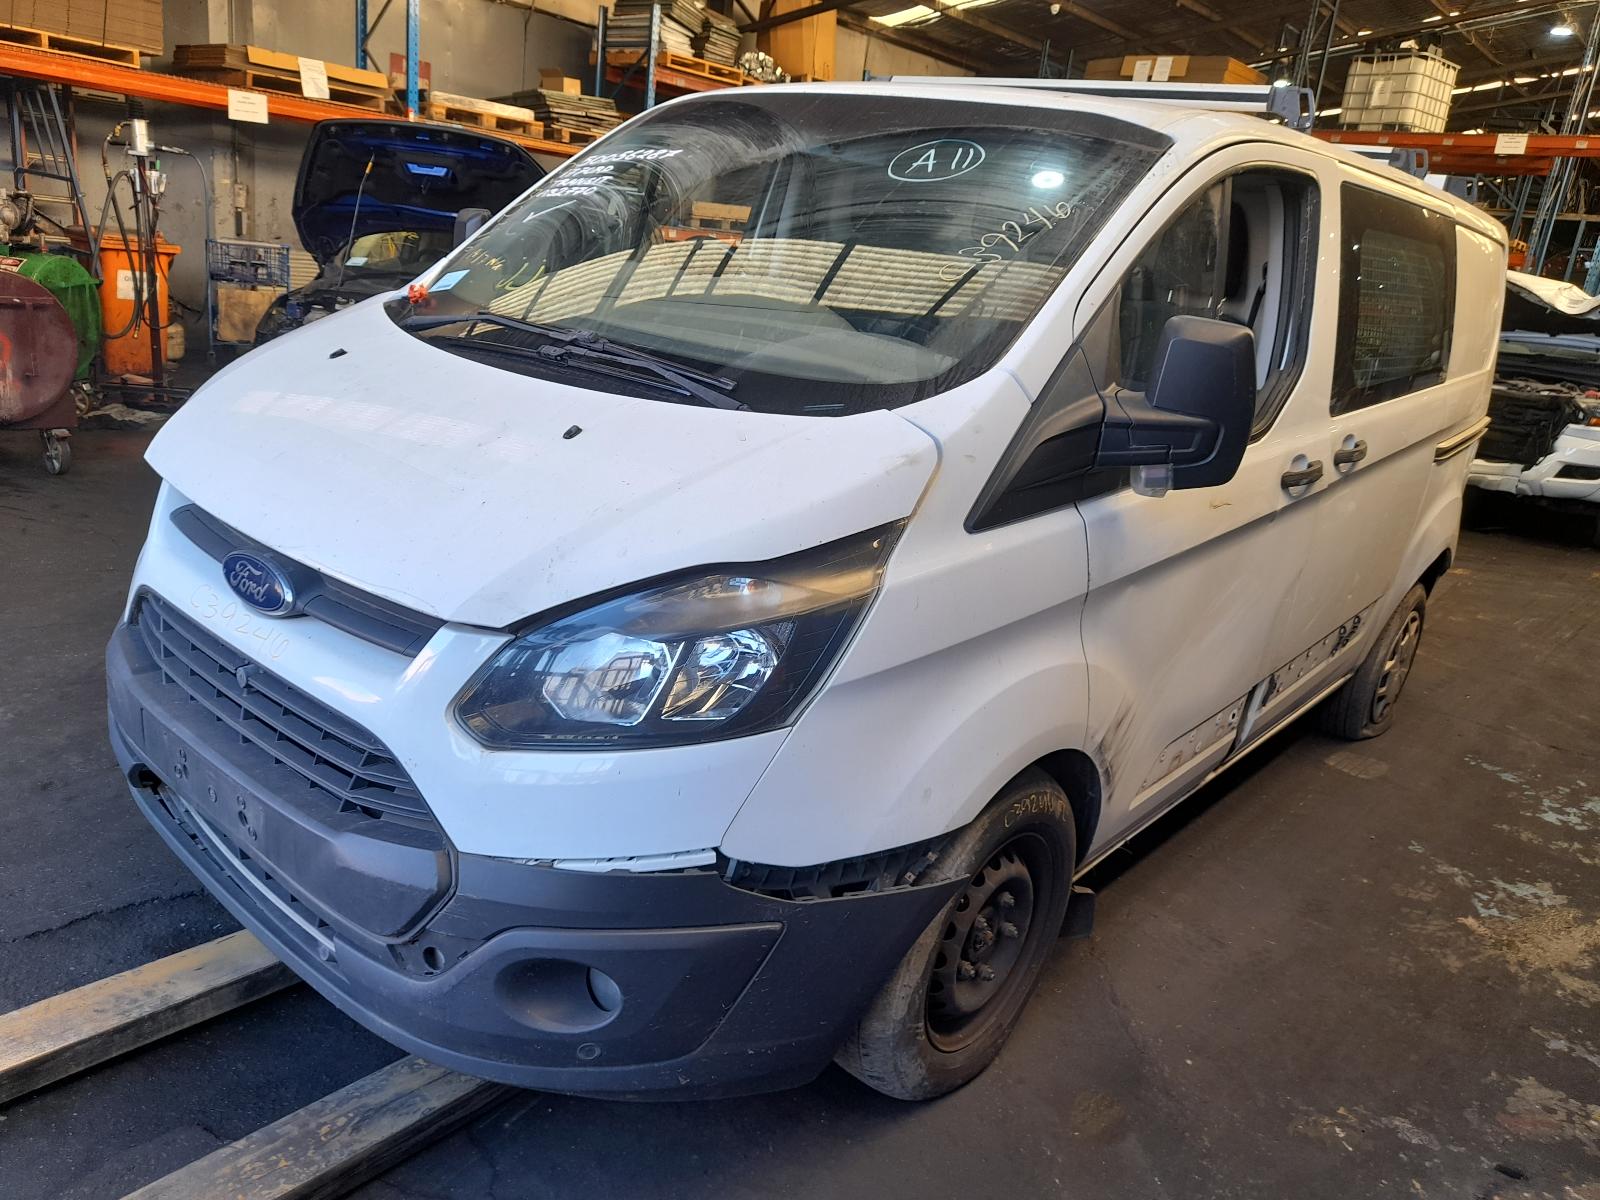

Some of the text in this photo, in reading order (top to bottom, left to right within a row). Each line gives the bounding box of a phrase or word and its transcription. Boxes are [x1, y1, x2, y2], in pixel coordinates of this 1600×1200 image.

[905, 148, 974, 175] A 11
[230, 560, 270, 603] Ford
